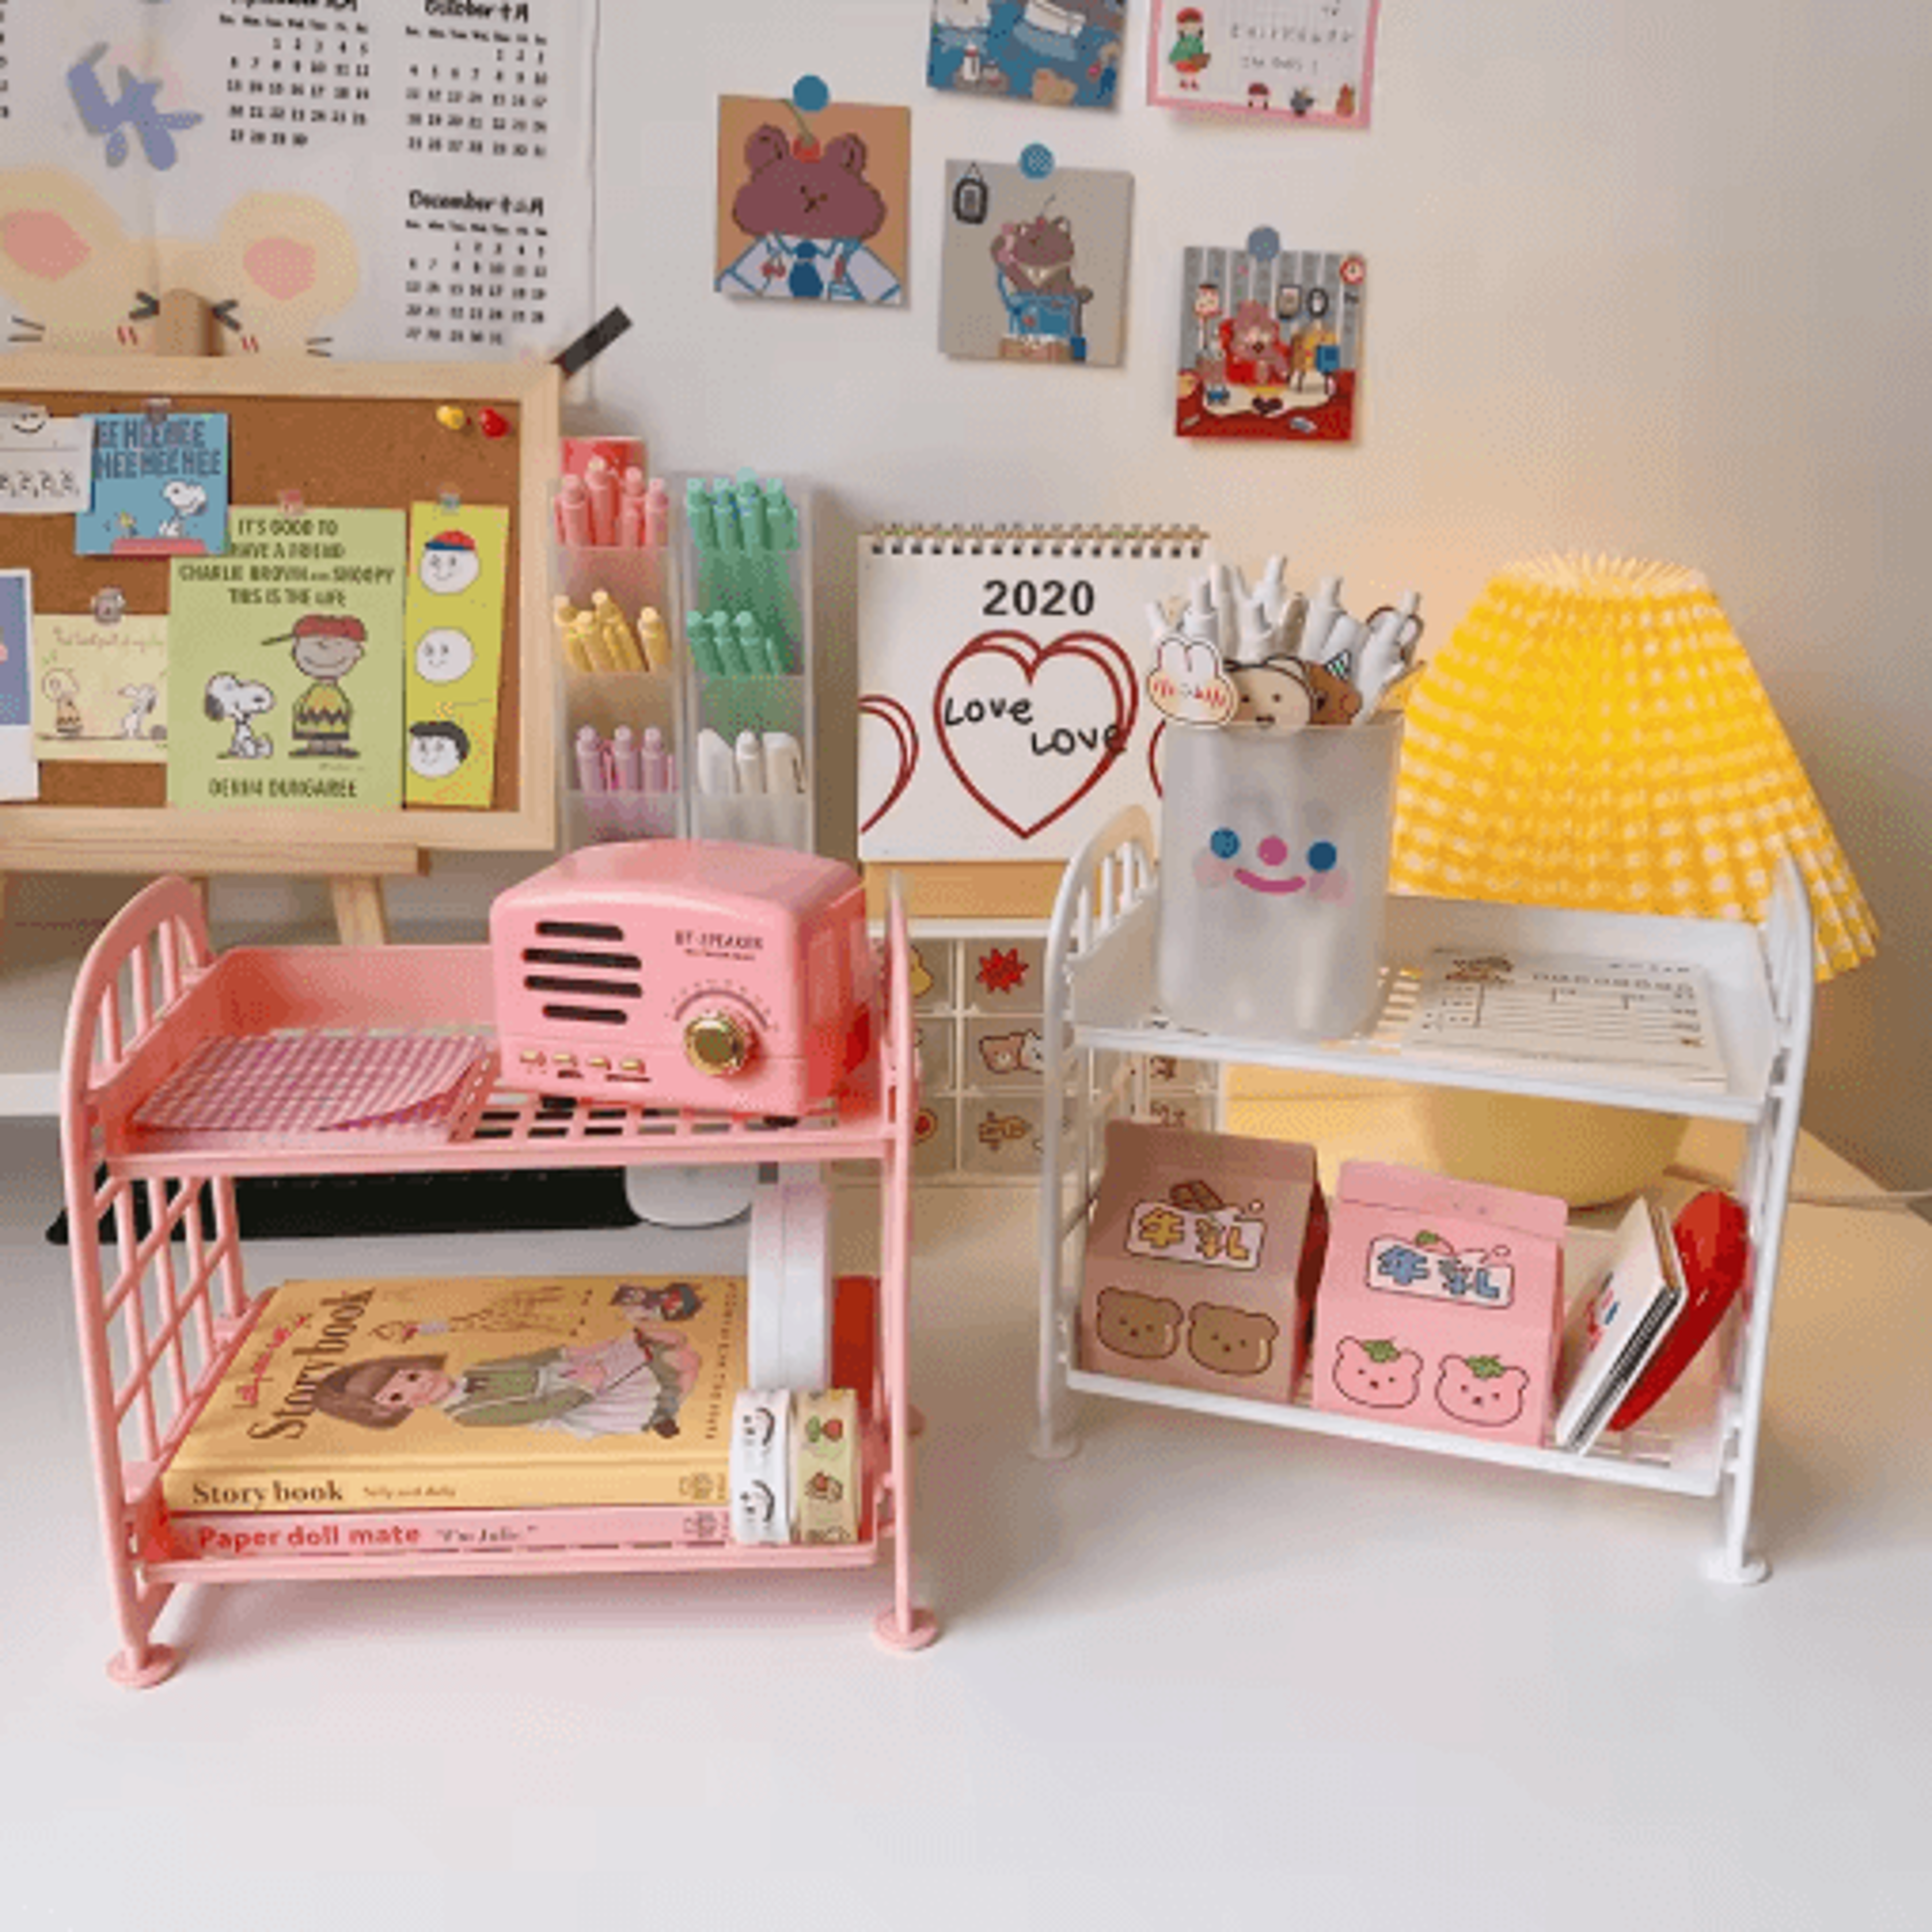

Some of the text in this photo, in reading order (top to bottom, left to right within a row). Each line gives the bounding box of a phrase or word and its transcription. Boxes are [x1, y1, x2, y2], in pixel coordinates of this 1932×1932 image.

[270, 520, 314, 536] GOOD
[318, 520, 338, 536] TO
[179, 565, 243, 582] CHARLIE
[266, 588, 281, 604] IS
[983, 581, 1094, 616] 2020
[192, 1480, 267, 1511] Story
[273, 1479, 343, 1502] book
[201, 1526, 287, 1553] Paper
[288, 1525, 340, 1547] doll
[349, 1526, 420, 1545] mate
